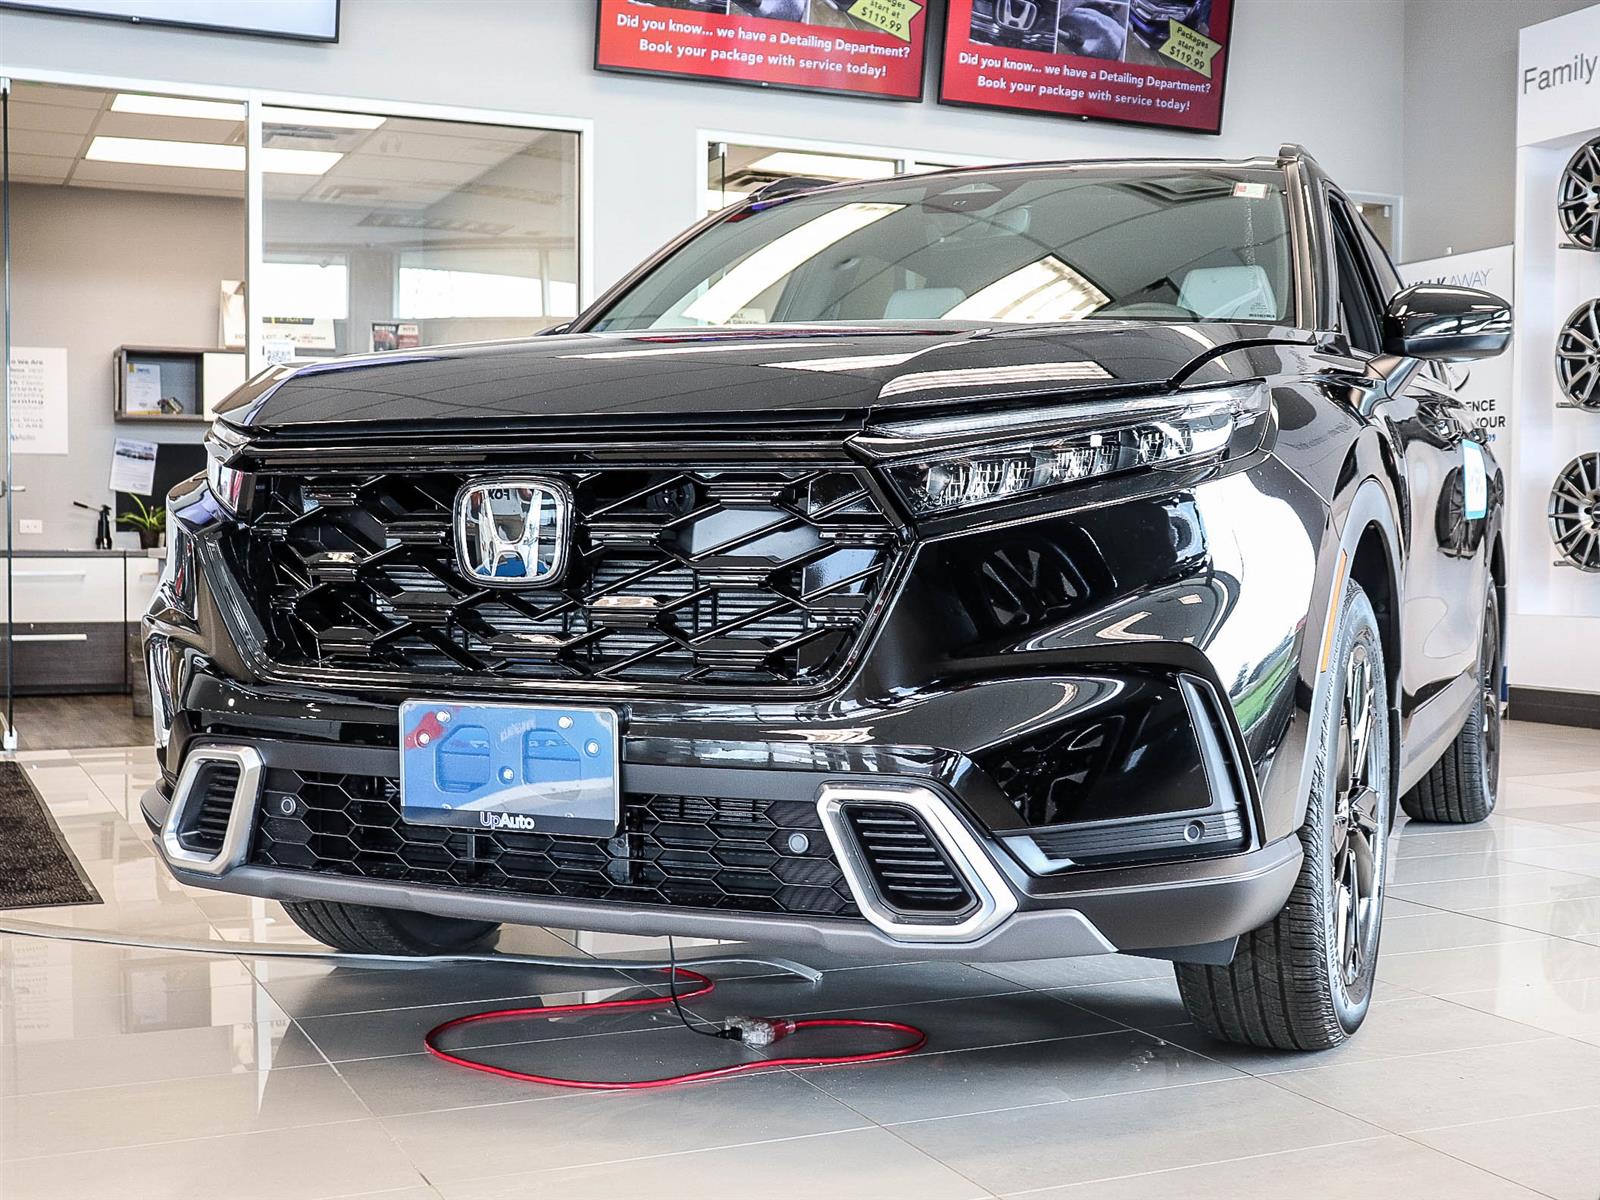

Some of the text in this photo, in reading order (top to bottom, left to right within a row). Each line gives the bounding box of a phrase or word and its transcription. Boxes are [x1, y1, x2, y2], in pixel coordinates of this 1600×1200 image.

[862, 6, 902, 32] $119.99
[870, 0, 890, 14] start
[617, 13, 910, 58] Did you know... we have a Detailing Department?
[1176, 26, 1208, 49] Packages
[1178, 40, 1195, 52] start
[640, 39, 886, 78] Book your package with service today!
[1170, 46, 1204, 70] $119.99
[959, 52, 1212, 94] Did you know... we have a Detailing Department?
[1524, 52, 1598, 94] Family
[978, 76, 1190, 112] Book your package with service today!
[1450, 270, 1490, 287] AWAY
[480, 811, 535, 830] UpAuto
